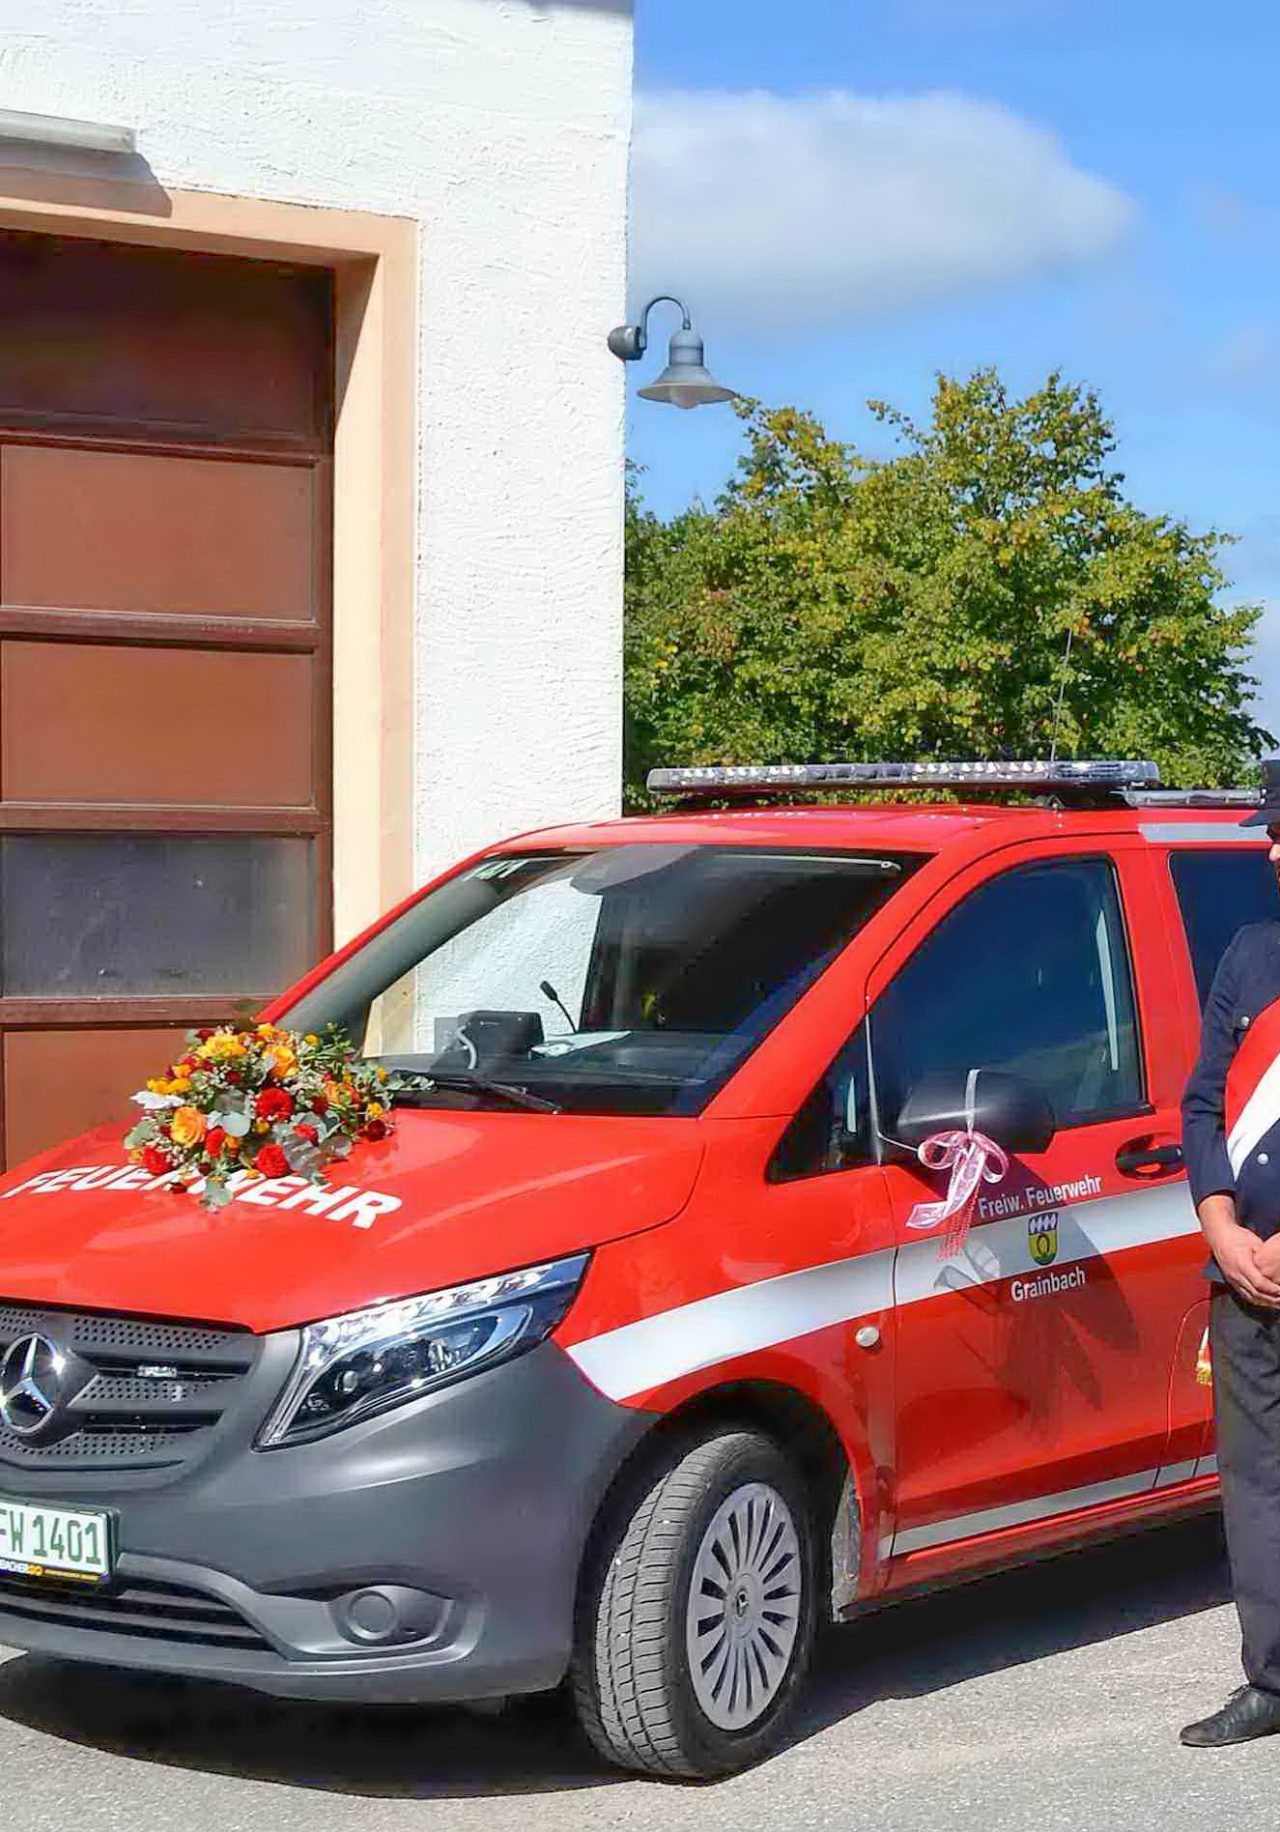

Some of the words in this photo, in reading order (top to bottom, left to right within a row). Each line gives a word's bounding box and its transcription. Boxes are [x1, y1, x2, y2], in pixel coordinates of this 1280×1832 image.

[977, 1193, 1025, 1219] Freiw.
[1025, 1174, 1102, 1208] Feuerwehr
[1010, 1265, 1087, 1302] Grainbach
[32, 1514, 102, 1566] 1401
